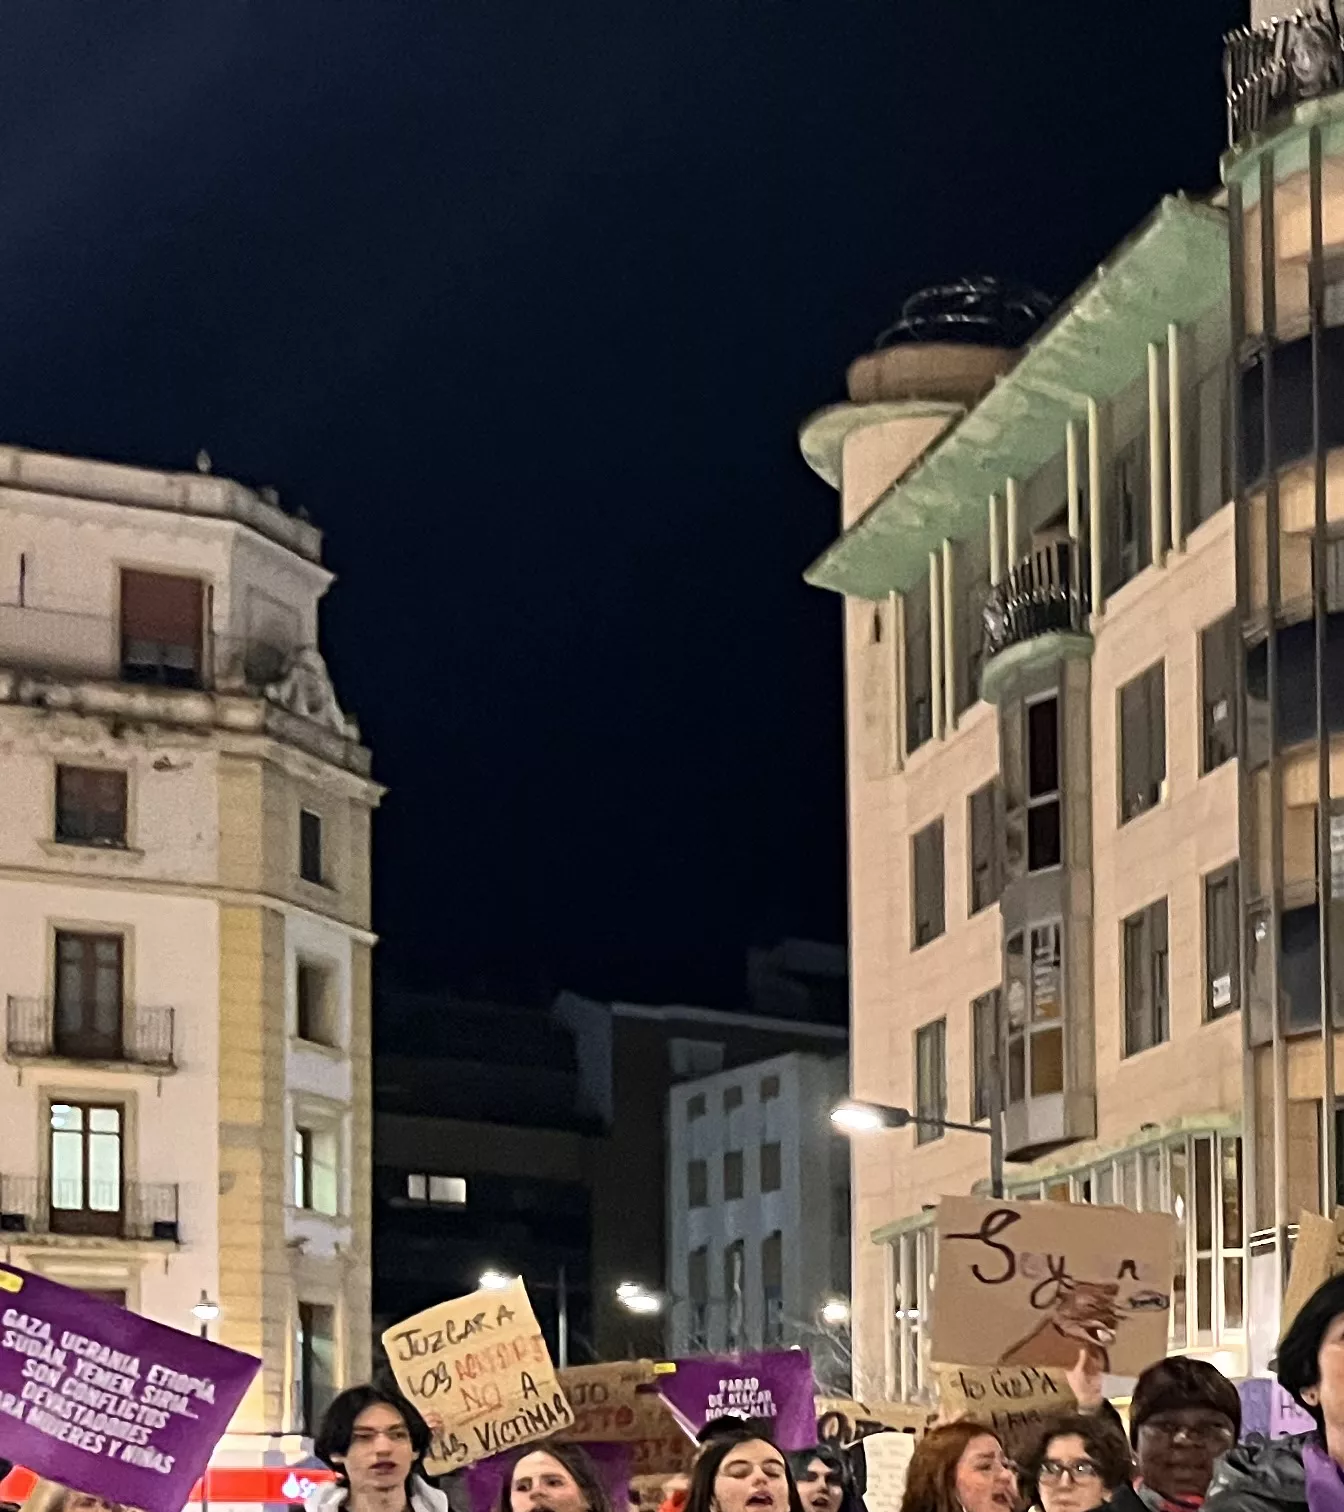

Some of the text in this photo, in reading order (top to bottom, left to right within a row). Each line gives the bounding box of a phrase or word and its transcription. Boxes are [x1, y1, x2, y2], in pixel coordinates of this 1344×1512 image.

[21, 1358, 170, 1430] SON CONFLICTOS
[21, 1380, 152, 1445] DEVASTADORES
[459, 1371, 540, 1412] NO A
[708, 1393, 726, 1408] DE
[25, 1406, 107, 1455] MUJERES
[107, 1440, 123, 1458] Y
